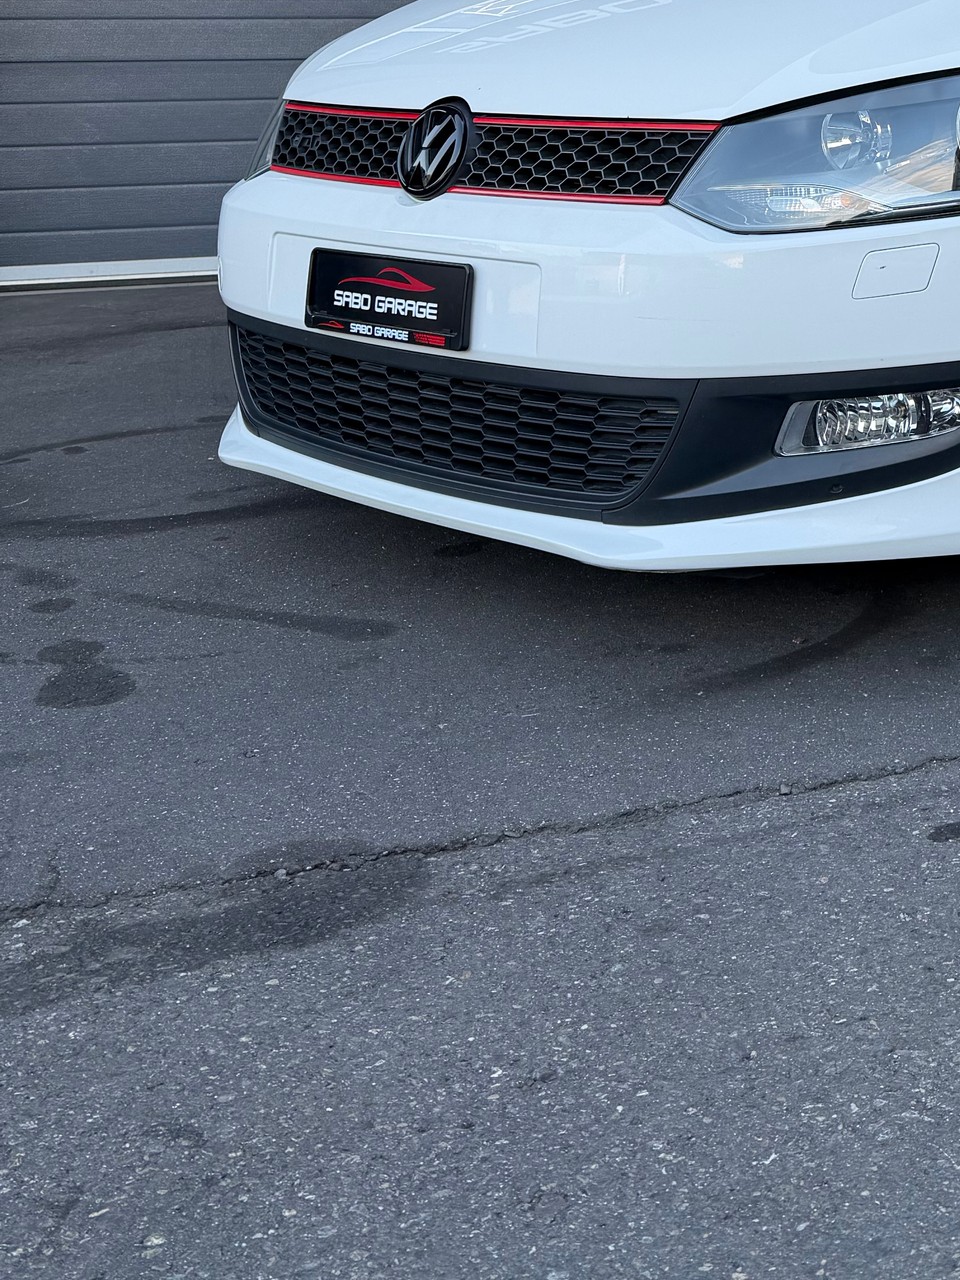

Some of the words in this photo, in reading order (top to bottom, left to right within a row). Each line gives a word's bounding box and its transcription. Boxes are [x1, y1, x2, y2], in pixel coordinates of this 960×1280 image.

[333, 289, 371, 310] SABO
[374, 296, 438, 320] GARAGE
[349, 323, 373, 336] SABO
[374, 327, 409, 341] GARAGE
